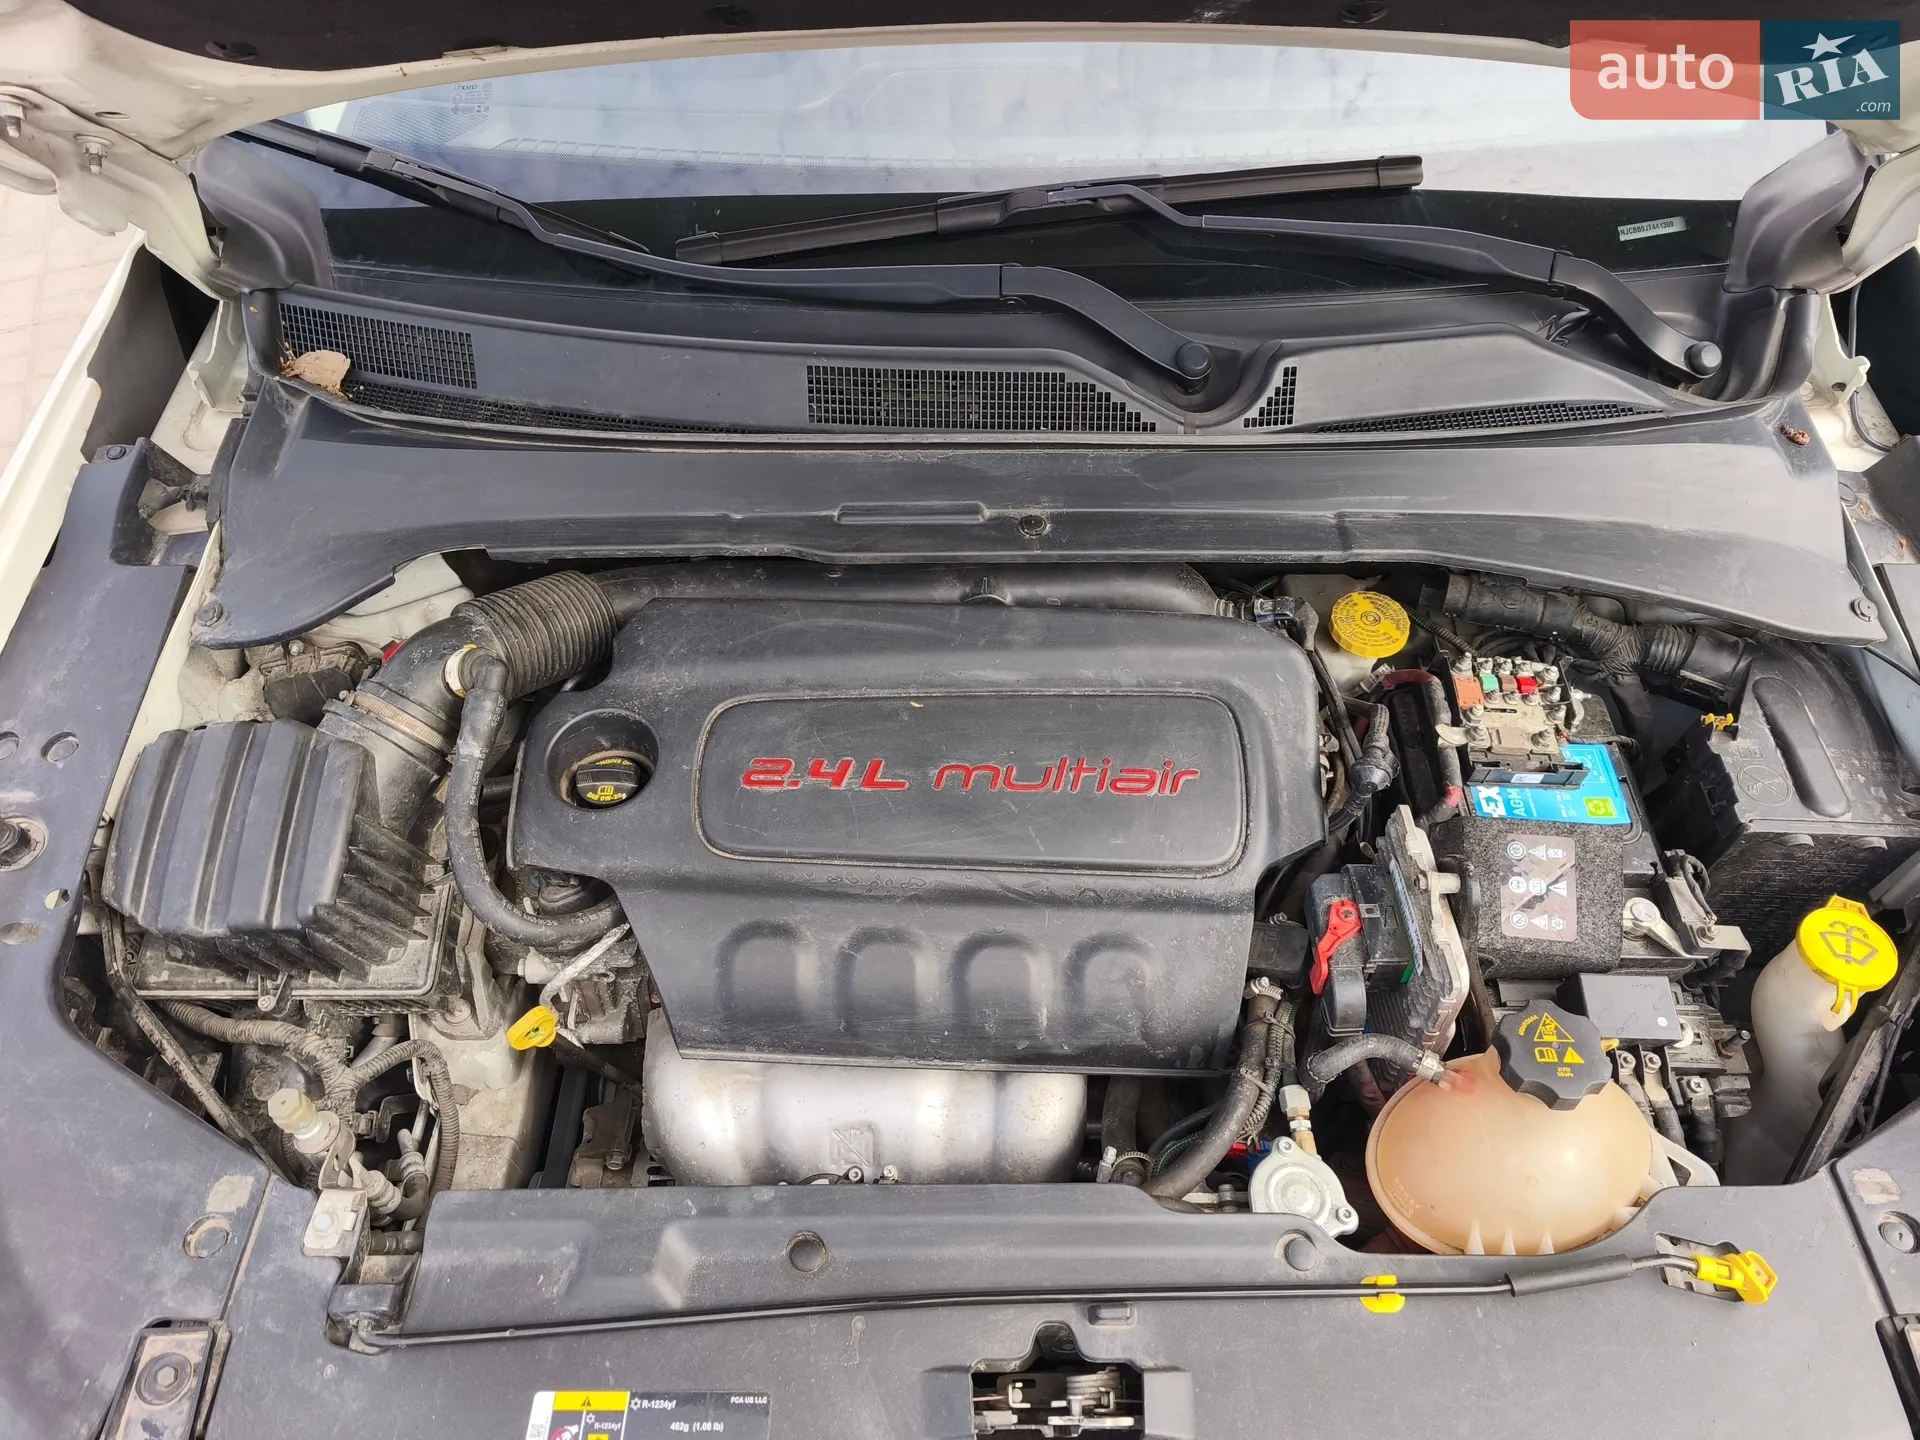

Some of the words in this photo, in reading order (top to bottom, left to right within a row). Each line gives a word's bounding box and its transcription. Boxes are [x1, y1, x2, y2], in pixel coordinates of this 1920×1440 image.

[741, 757, 909, 790] 2.4L
[933, 756, 1199, 796] multiair
[1506, 788, 1528, 817] AGM
[641, 1400, 676, 1410] R-1234yf
[730, 1396, 744, 1404] FCA
[744, 1396, 753, 1404] US
[754, 1396, 768, 1404] LLC
[713, 1421, 724, 1432] lb)
